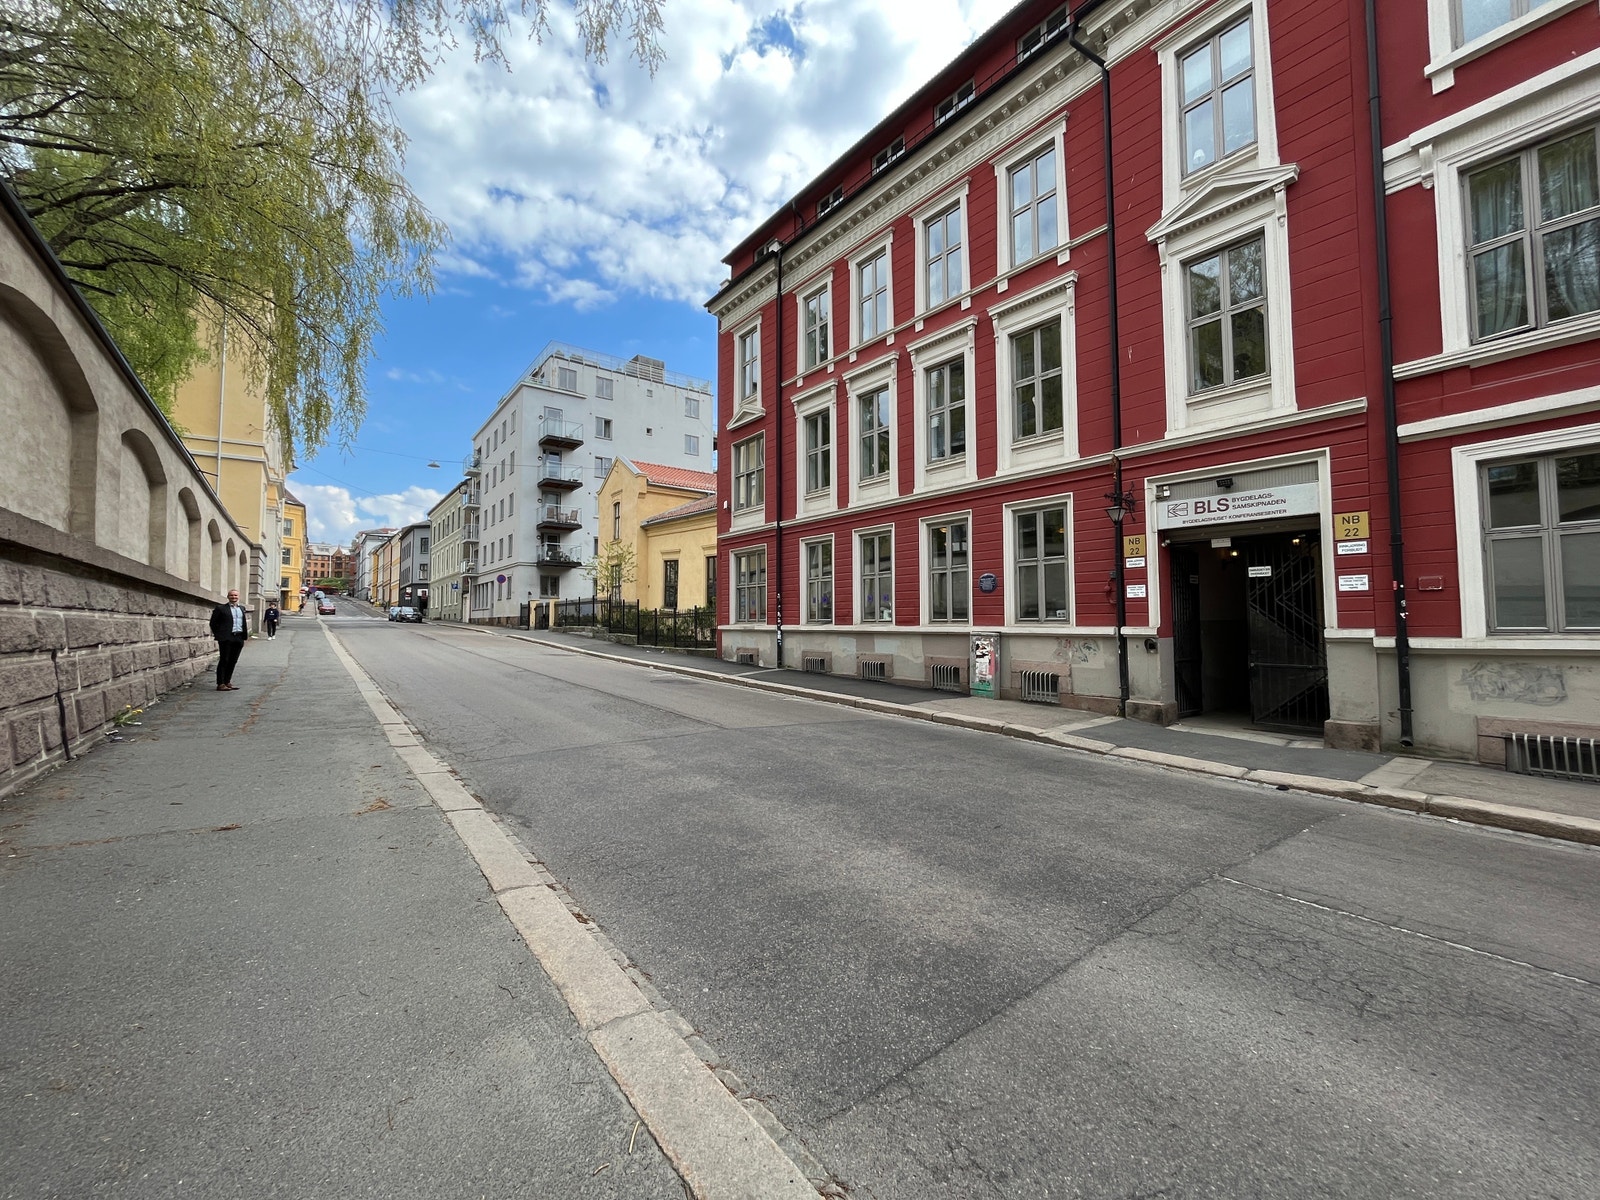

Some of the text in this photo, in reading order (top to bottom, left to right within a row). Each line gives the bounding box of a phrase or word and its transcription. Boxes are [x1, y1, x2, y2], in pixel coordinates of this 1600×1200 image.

[1232, 492, 1274, 502] BYGDELAGS-
[1194, 498, 1230, 514] BLS
[1232, 499, 1286, 510] SAMSKIPNADEN
[1182, 510, 1287, 524] BYGDELAGSHUSET KONFERANSESENTER
[1342, 515, 1360, 524] NB
[1344, 528, 1359, 537] 22
